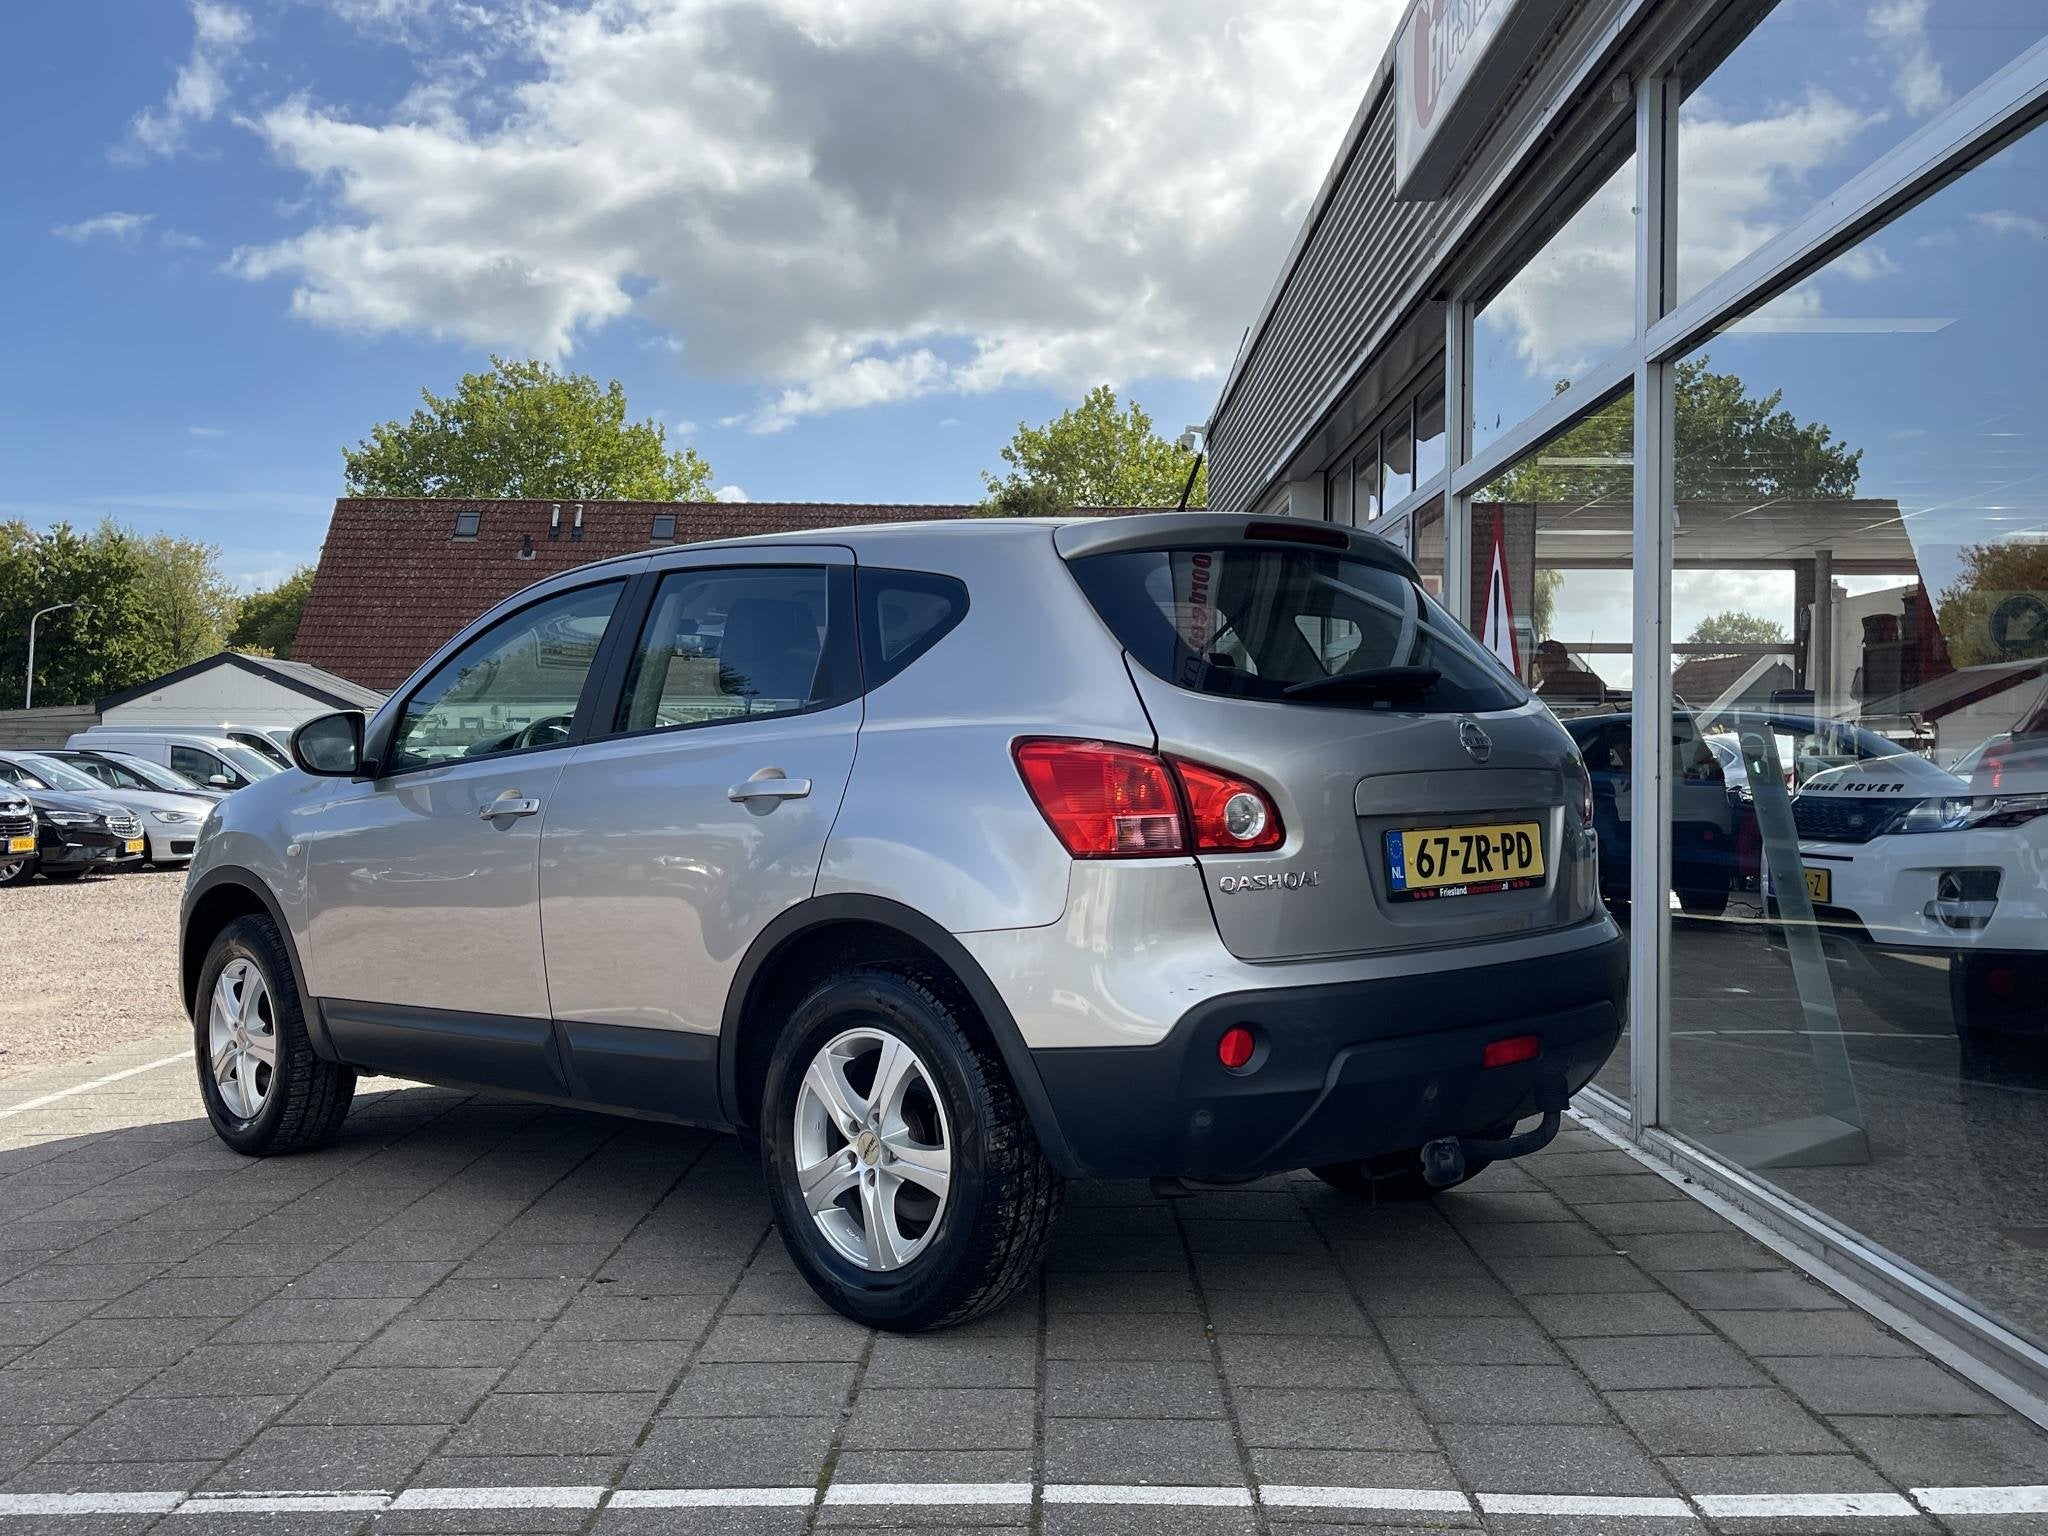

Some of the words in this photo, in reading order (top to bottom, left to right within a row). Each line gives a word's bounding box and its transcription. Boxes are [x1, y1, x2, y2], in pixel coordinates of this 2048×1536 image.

[1843, 783, 1905, 793] ROVER
[1416, 831, 1533, 879] 67-ZR-PD
[1219, 870, 1321, 894] QASHQAI
[1391, 866, 1405, 880] NL
